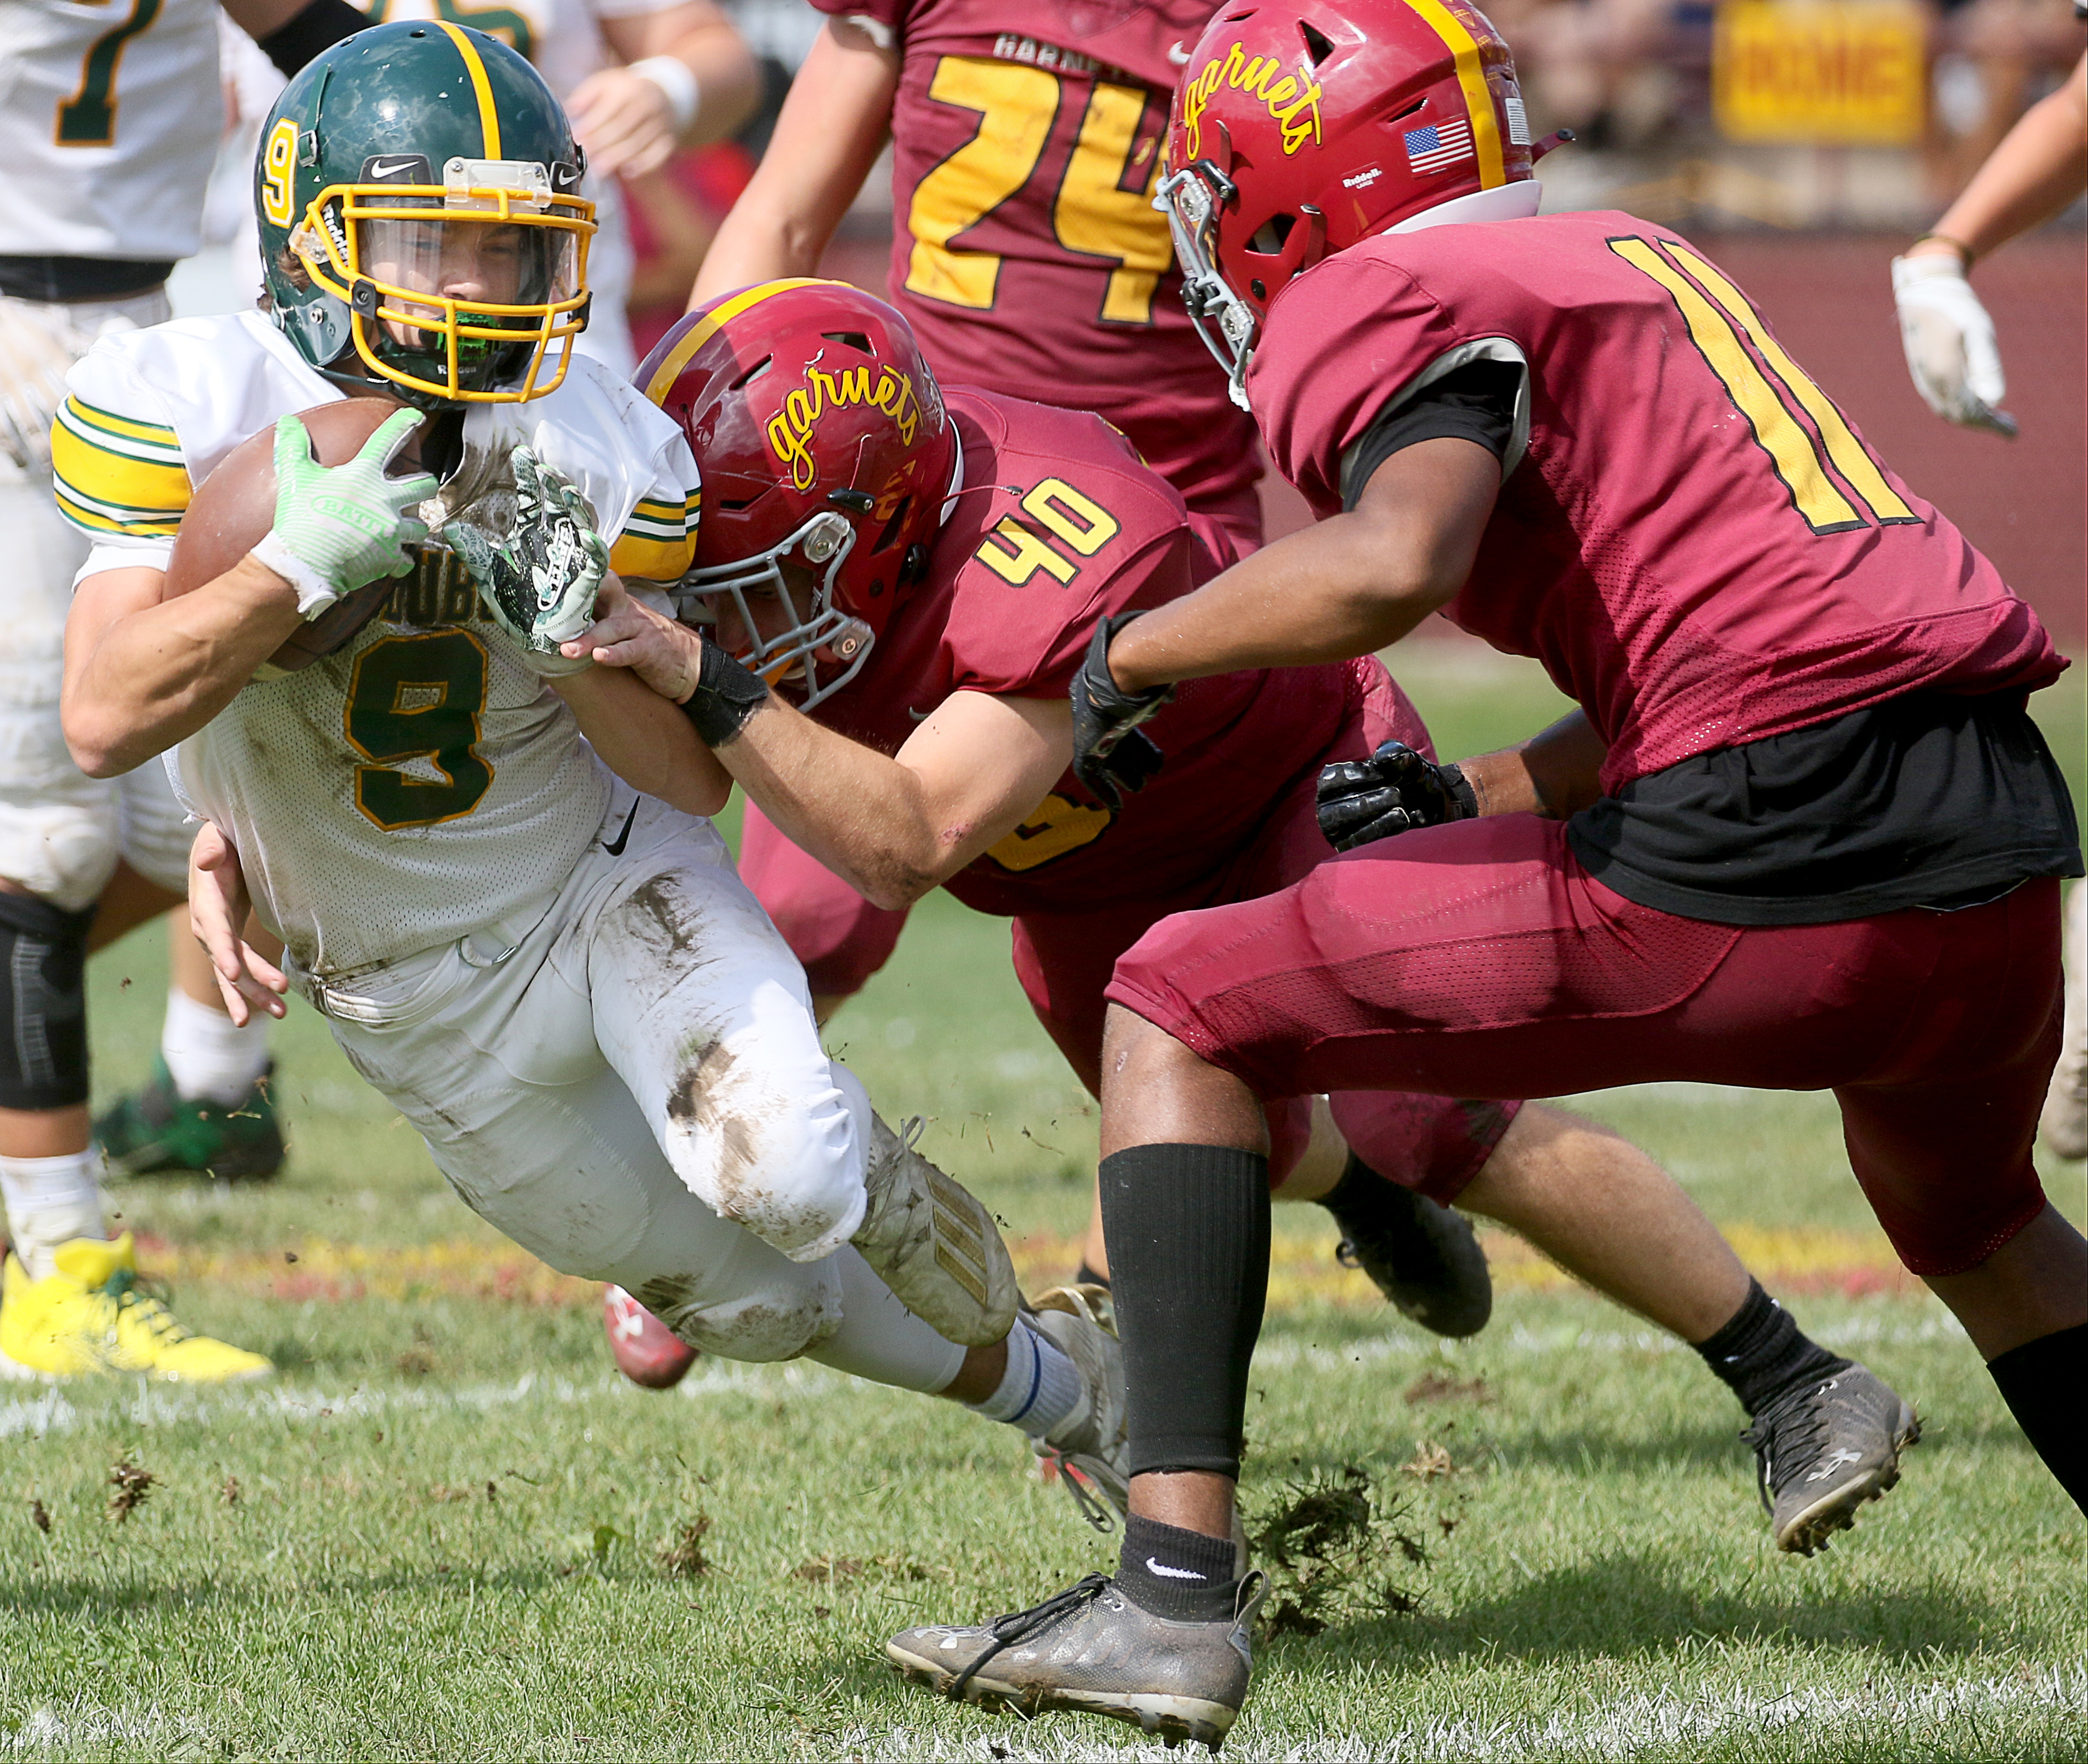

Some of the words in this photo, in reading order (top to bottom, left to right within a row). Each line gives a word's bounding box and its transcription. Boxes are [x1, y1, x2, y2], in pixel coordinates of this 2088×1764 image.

[54, 0, 163, 147] 7
[1184, 41, 1322, 161] garnets
[262, 117, 299, 229] 9
[904, 55, 1177, 326] 24
[1342, 168, 1383, 188] Riddell
[767, 366, 924, 490] garnets
[1605, 233, 1926, 536] 11
[972, 477, 1121, 588] 40
[343, 628, 495, 832] 9
